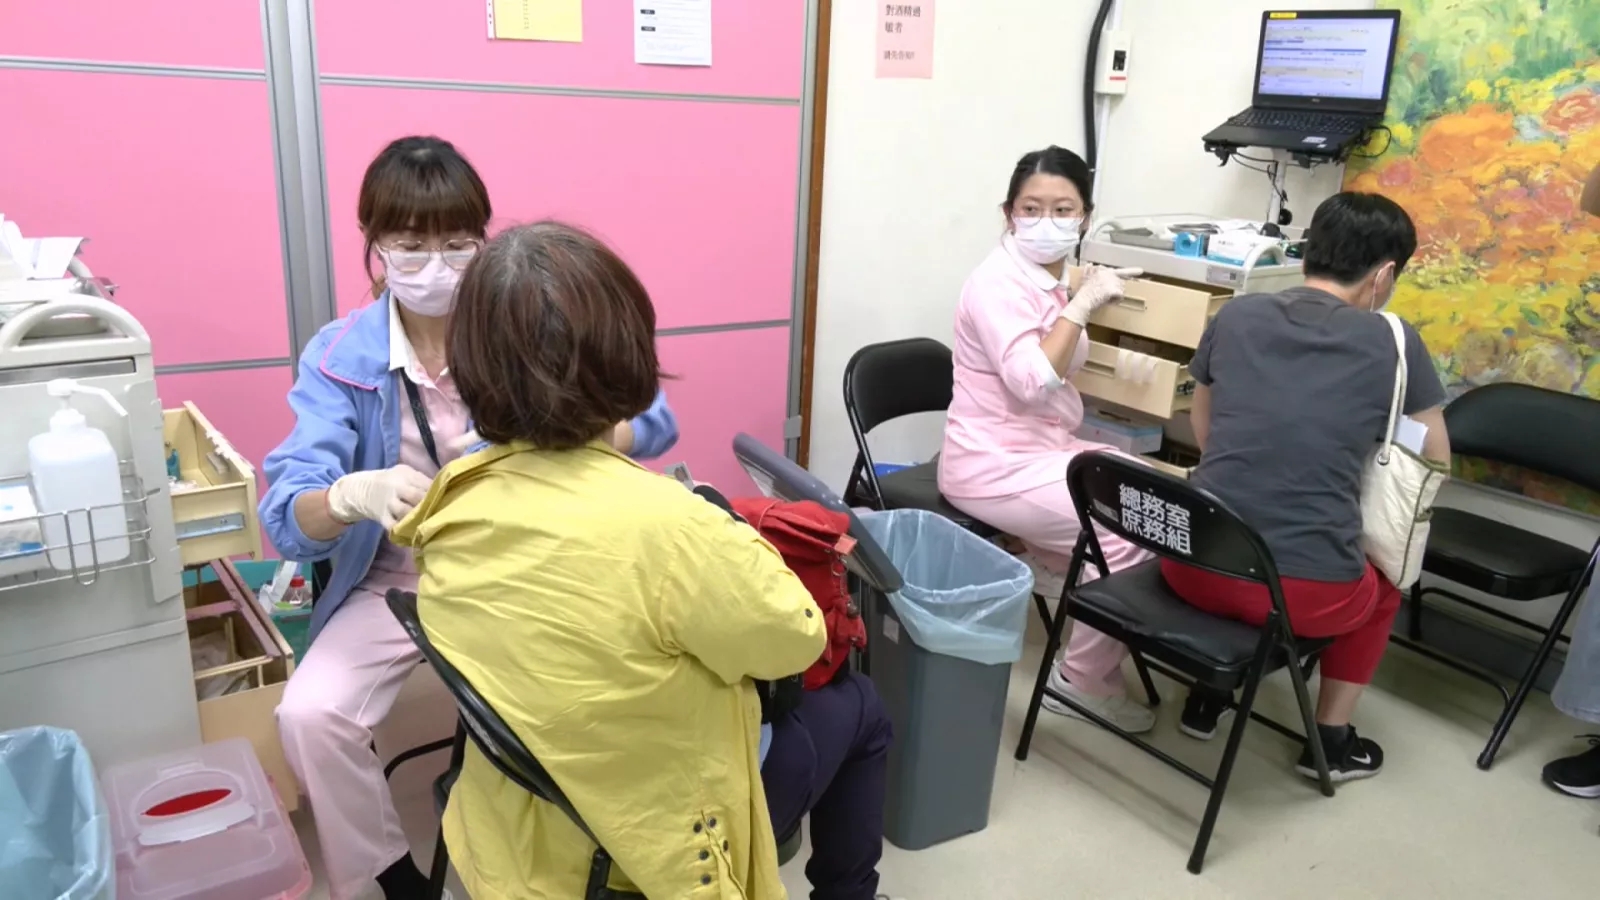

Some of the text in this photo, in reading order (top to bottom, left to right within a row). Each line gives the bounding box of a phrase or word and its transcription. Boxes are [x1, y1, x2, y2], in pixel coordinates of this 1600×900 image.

[885, 4, 921, 17] 對酒精過
[1119, 483, 1190, 531] 總務室
[1122, 507, 1192, 554] 庶務組
